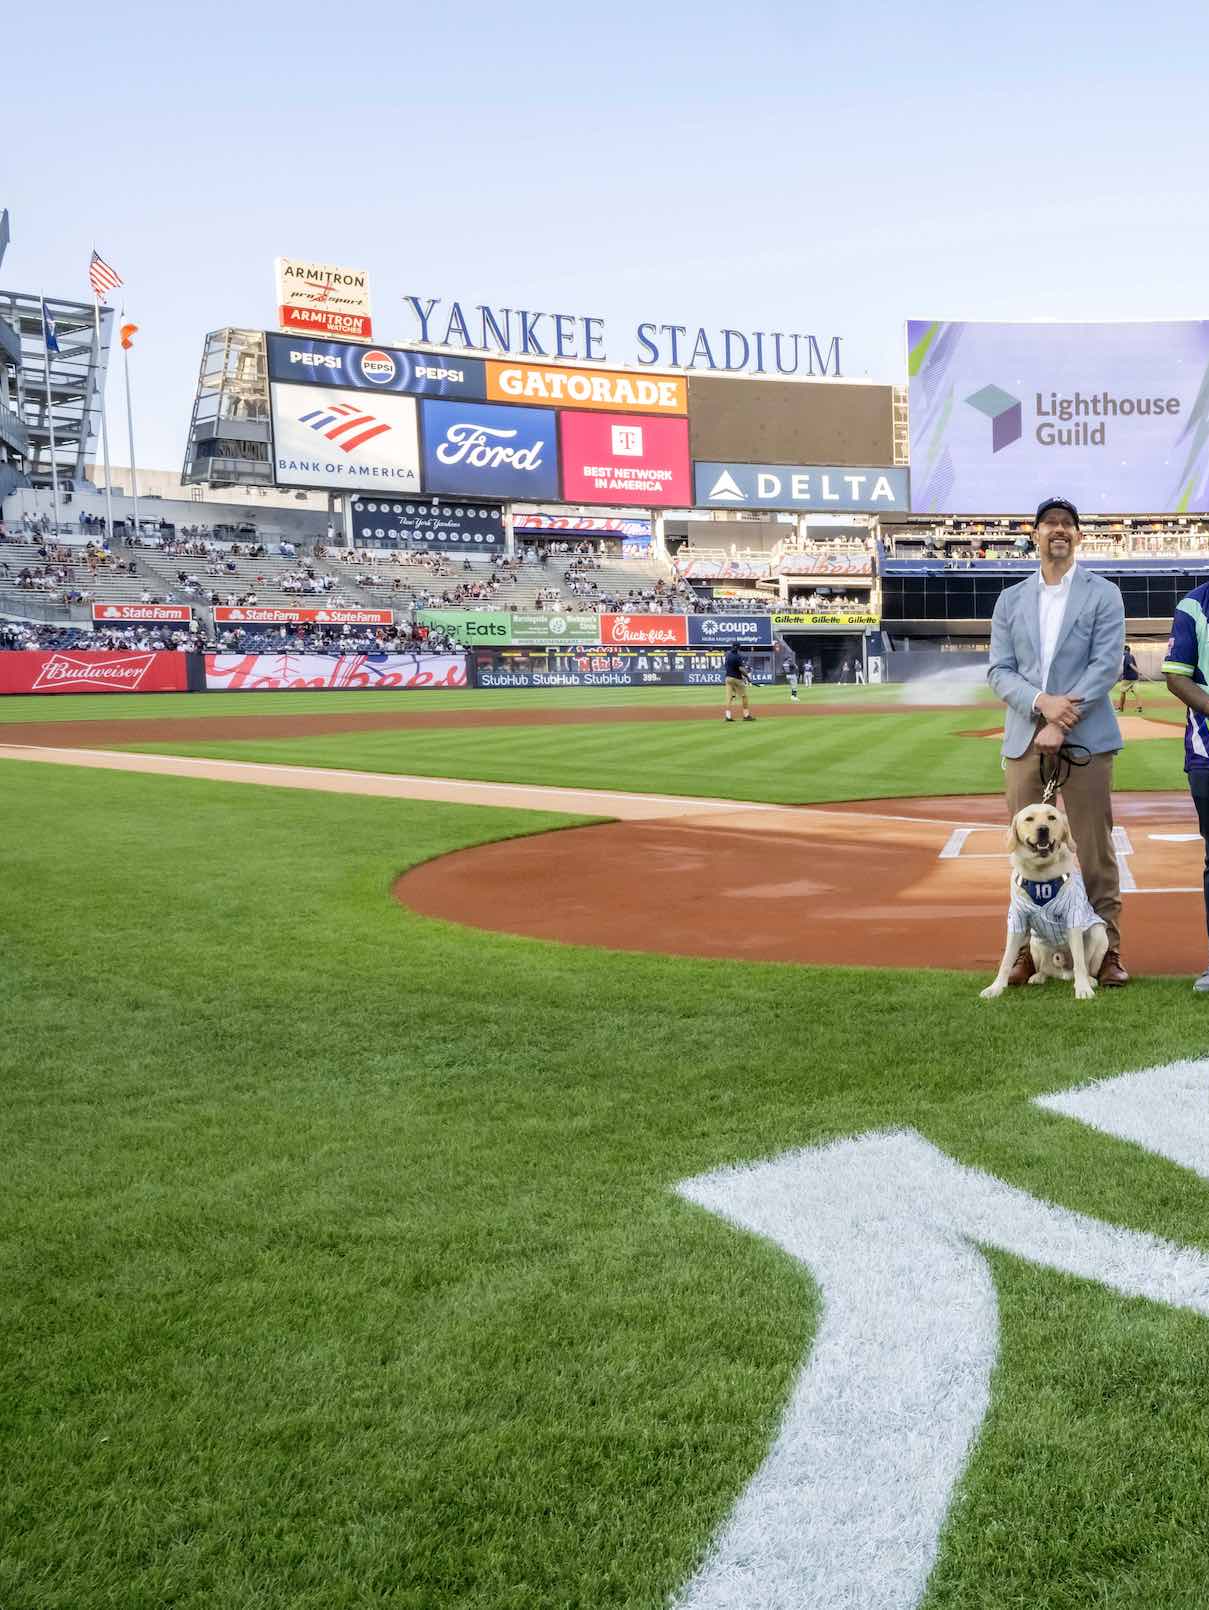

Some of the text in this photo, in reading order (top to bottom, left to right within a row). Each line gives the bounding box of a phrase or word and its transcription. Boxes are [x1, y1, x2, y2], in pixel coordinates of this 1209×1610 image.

[285, 266, 365, 287] ARMITRON
[291, 309, 364, 328] ARMITRON
[327, 323, 362, 334] WATCHES
[402, 296, 843, 377] YANKEE STADIUM
[290, 351, 464, 383] PEPSI PEPSI PEPSI
[499, 369, 678, 407] GATORADE
[1036, 392, 1181, 421] Lighthouse
[1036, 422, 1105, 446] Guild
[436, 423, 544, 471] Ford
[279, 459, 415, 478] BANK OF AMERICA
[584, 465, 673, 480] BEST NETWORK
[595, 478, 663, 492] IN AMERICA
[757, 473, 895, 502] DELTA
[414, 517, 432, 529] York
[432, 518, 460, 530] Yankees
[719, 621, 757, 635] coupa
[775, 616, 804, 624] Gillette
[811, 616, 841, 624] Gillette
[848, 616, 877, 624] Gillette
[466, 622, 507, 636] Eats
[41, 662, 145, 680] Budweiser
[688, 674, 722, 683] STARR
[482, 673, 631, 686] StubHub StubHub StubHub
[1035, 883, 1052, 899] 10
